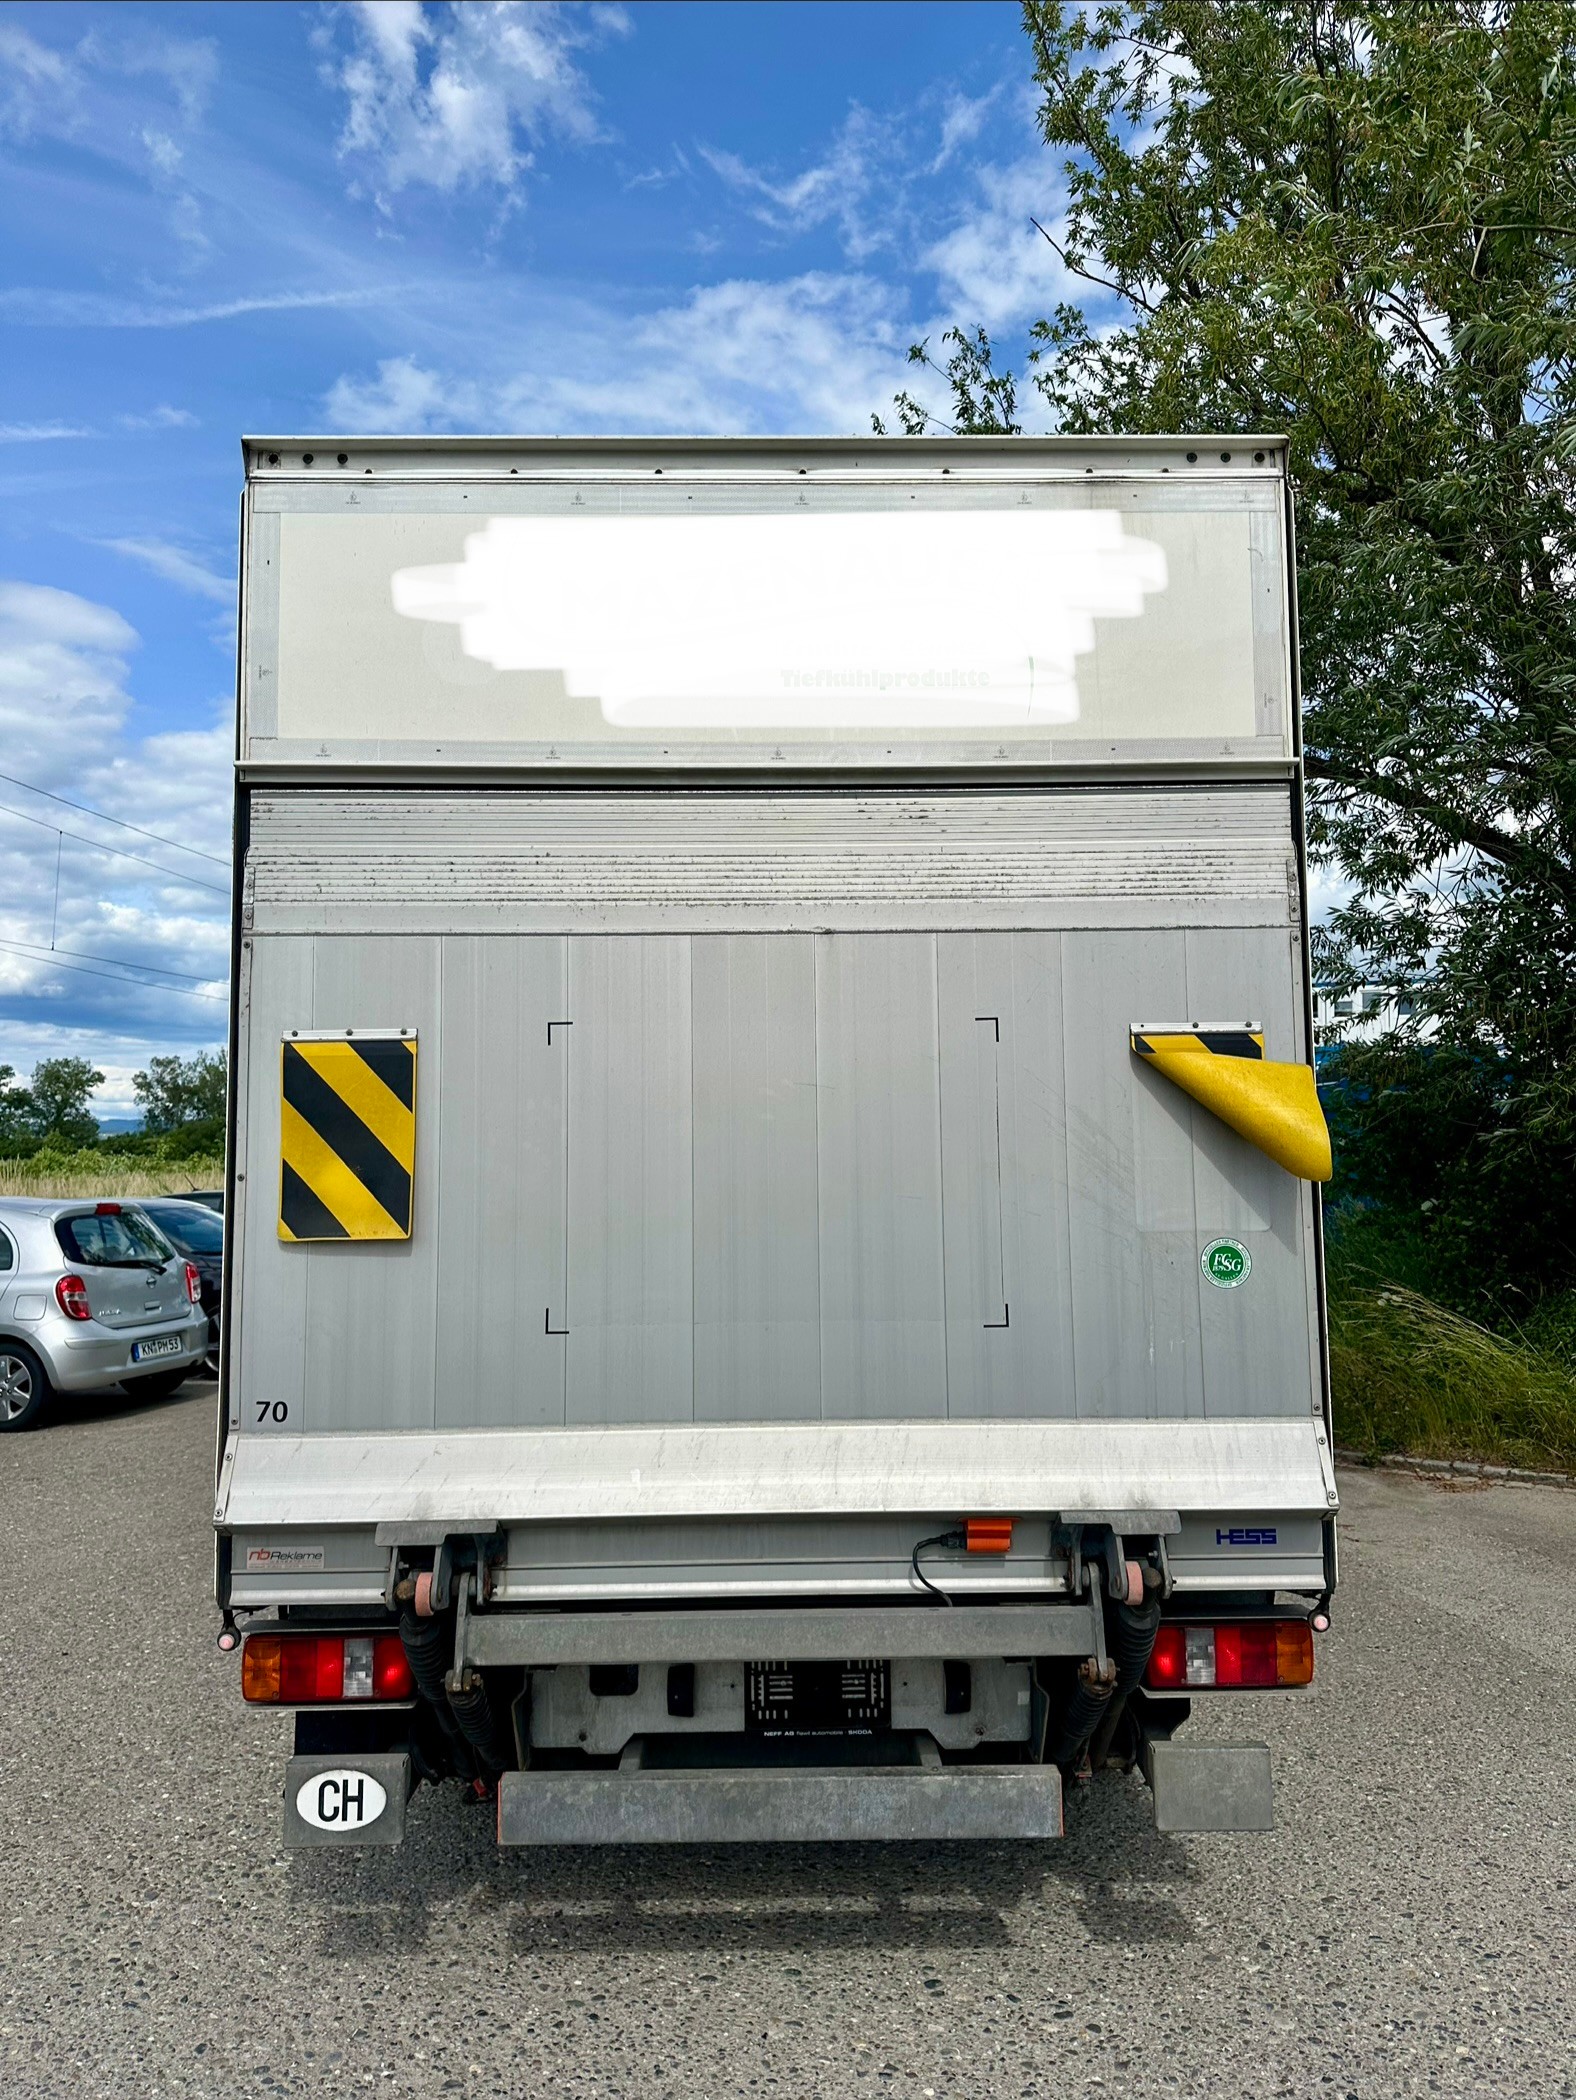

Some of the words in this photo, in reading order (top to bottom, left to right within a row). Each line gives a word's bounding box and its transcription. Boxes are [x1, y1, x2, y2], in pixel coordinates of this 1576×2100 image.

[141, 1342, 154, 1356] KN
[168, 1338, 179, 1351] 53
[256, 1401, 288, 1423] 70
[1215, 1528, 1277, 1545] HESS
[318, 1779, 364, 1822] CH
